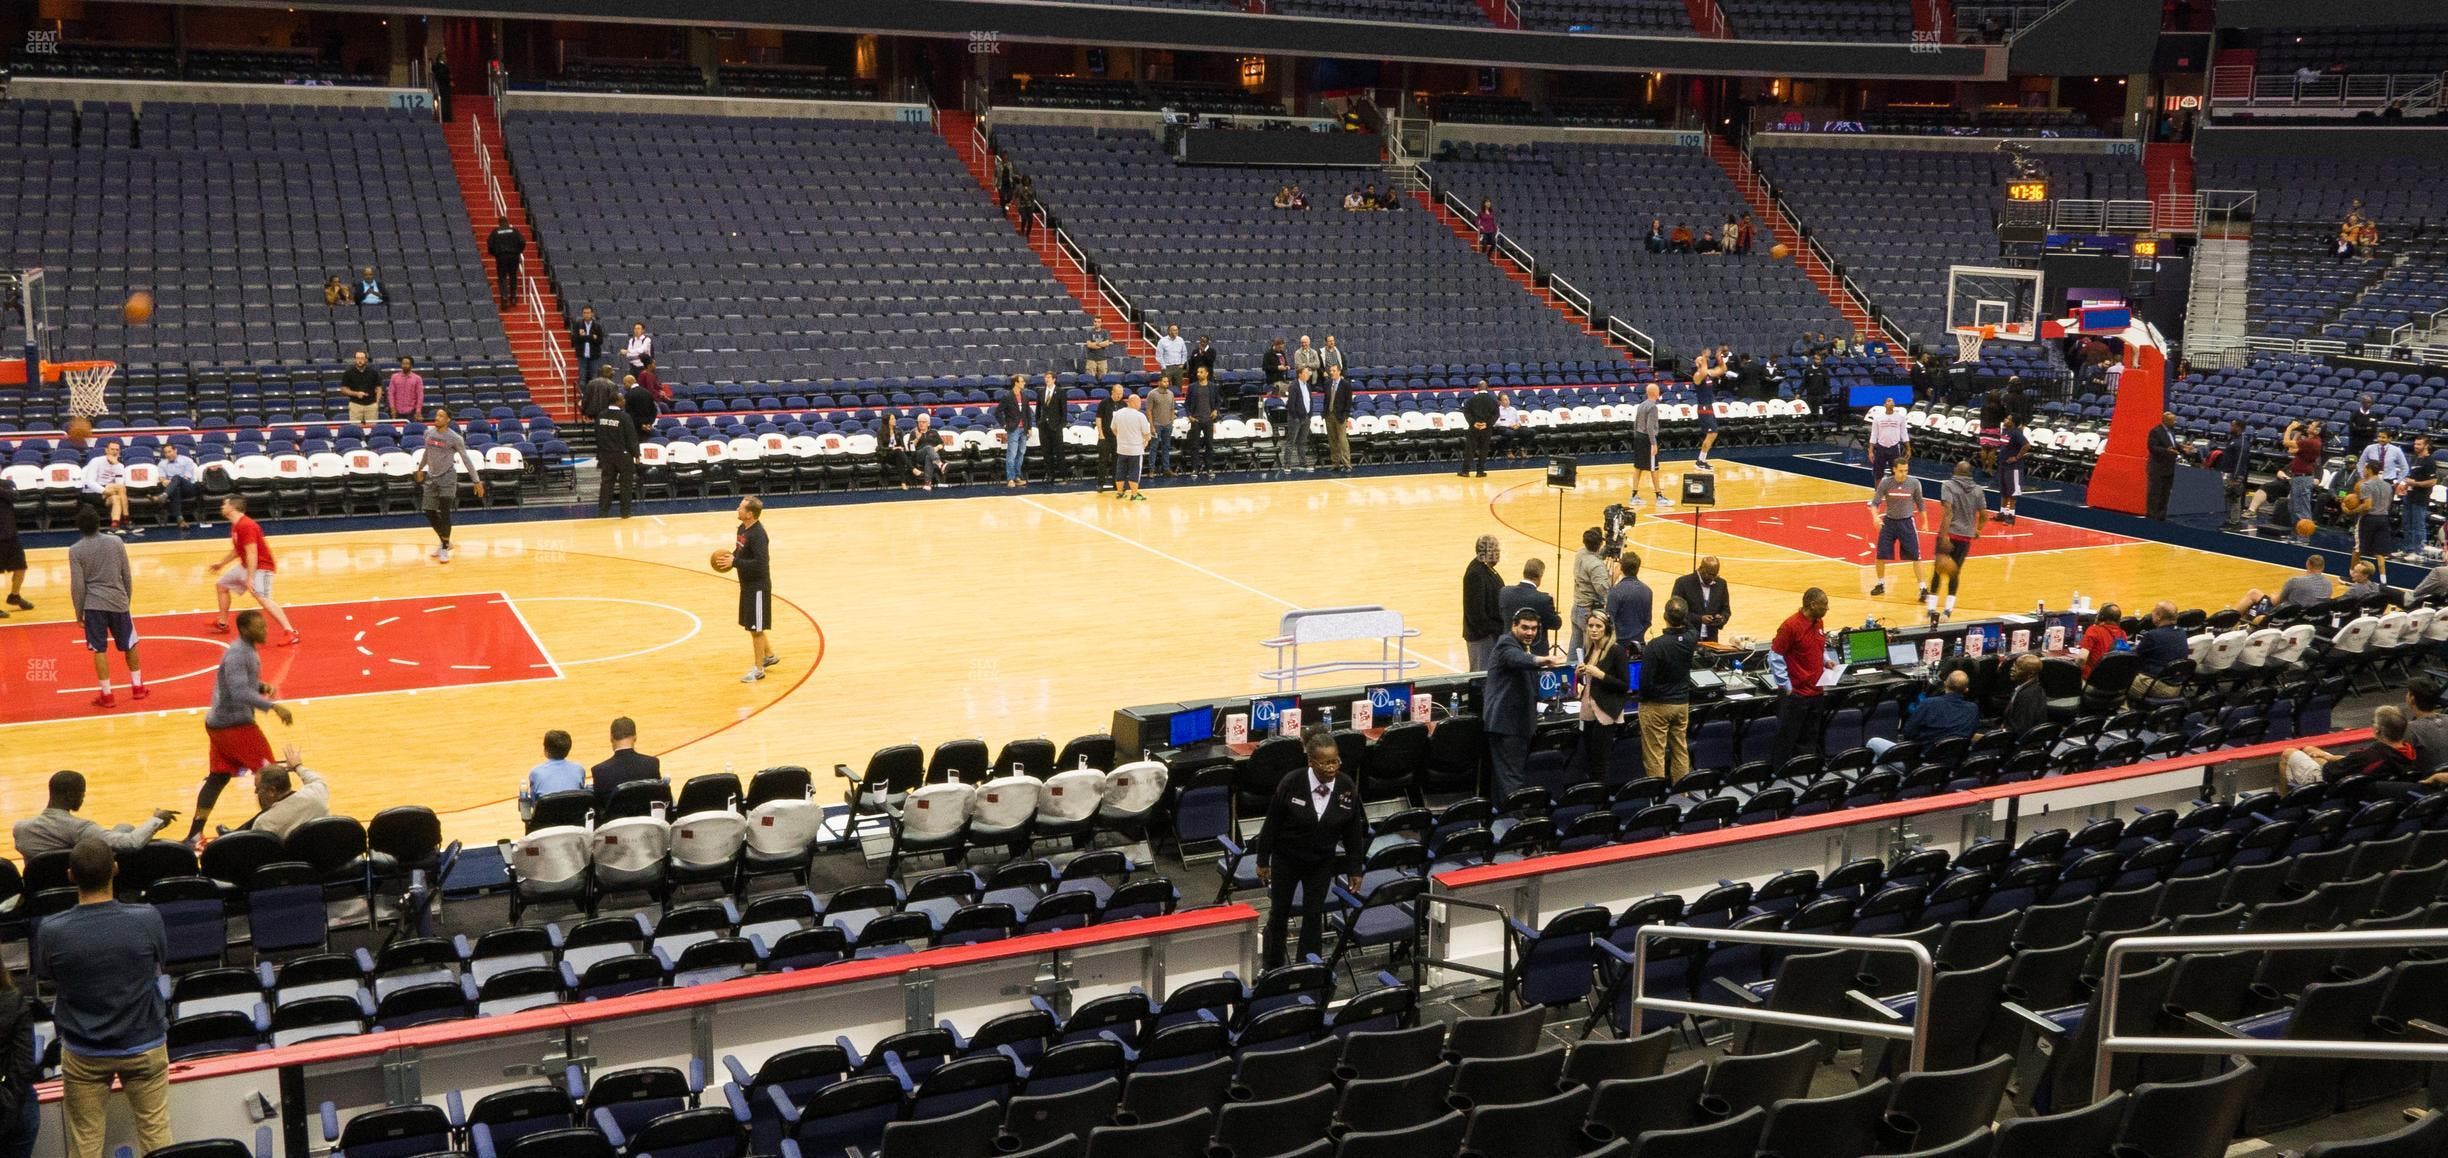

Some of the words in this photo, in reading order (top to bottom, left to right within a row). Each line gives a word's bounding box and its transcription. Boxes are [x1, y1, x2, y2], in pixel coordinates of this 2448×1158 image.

[398, 94, 424, 109] 112
[904, 110, 922, 122] 111
[1680, 135, 1700, 146] 109
[2111, 143, 2135, 155] 108
[2010, 183, 2044, 200] 47:36
